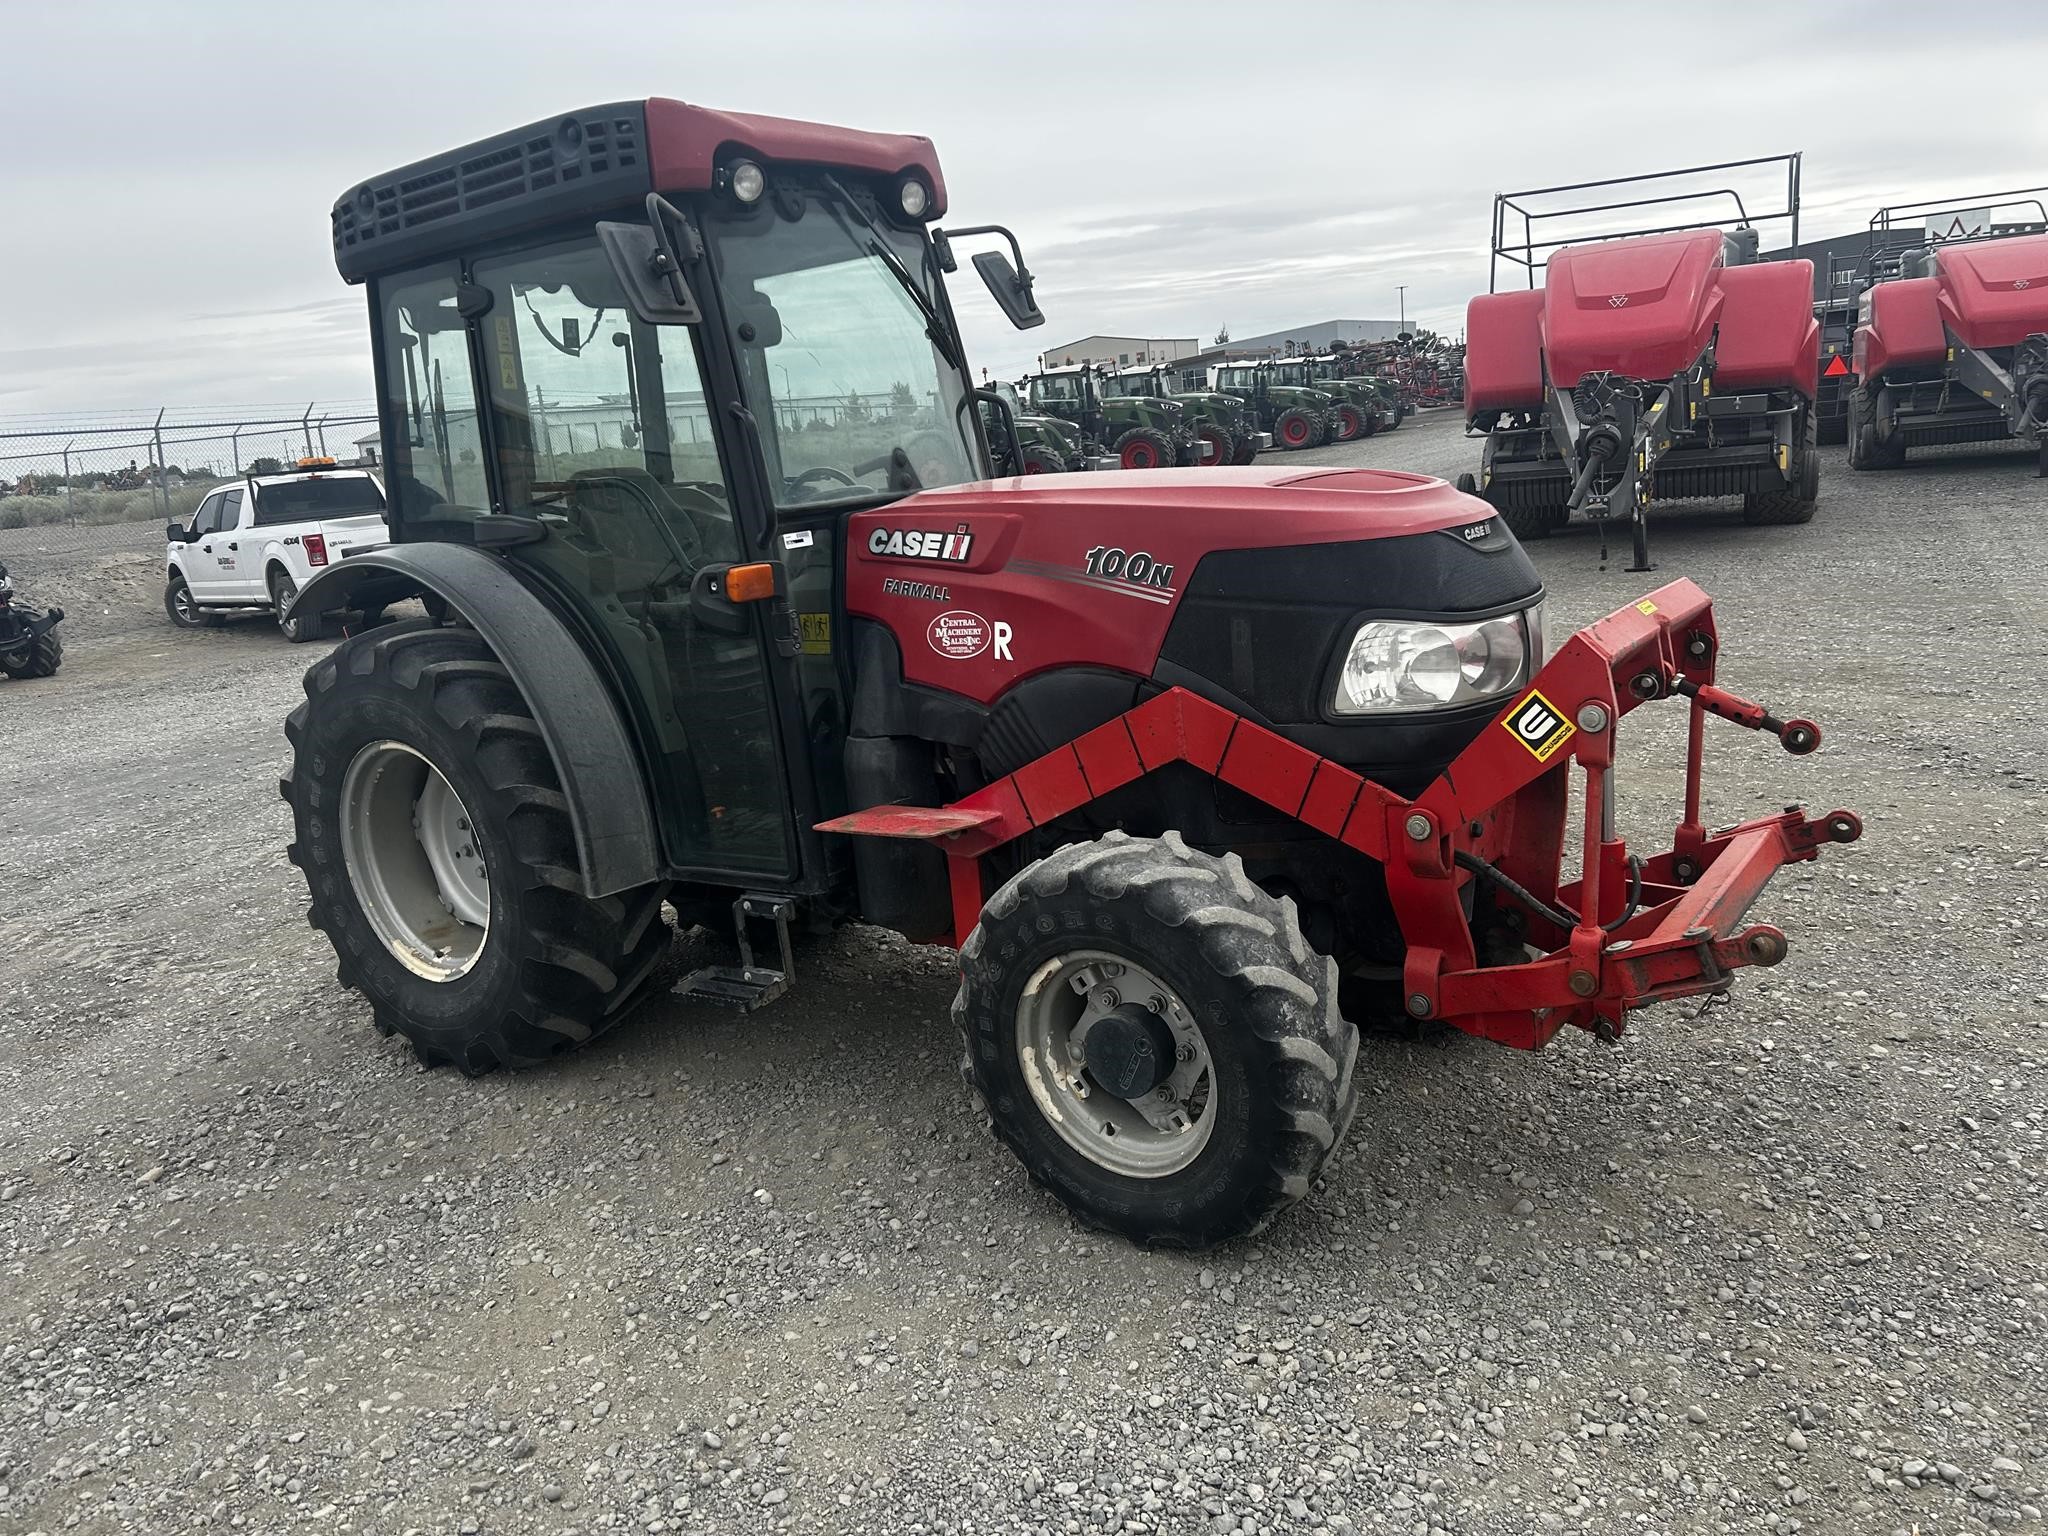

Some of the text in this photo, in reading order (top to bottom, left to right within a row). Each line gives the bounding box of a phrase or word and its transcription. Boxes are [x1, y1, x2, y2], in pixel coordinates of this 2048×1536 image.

[868, 528, 943, 558] CASE
[1464, 526, 1485, 540] CASE
[1085, 545, 1174, 588] 100N
[883, 578, 951, 601] FARMALL
[935, 627, 982, 638] MACHINERY
[940, 617, 977, 628] CENTRAL
[993, 621, 1014, 660] R
